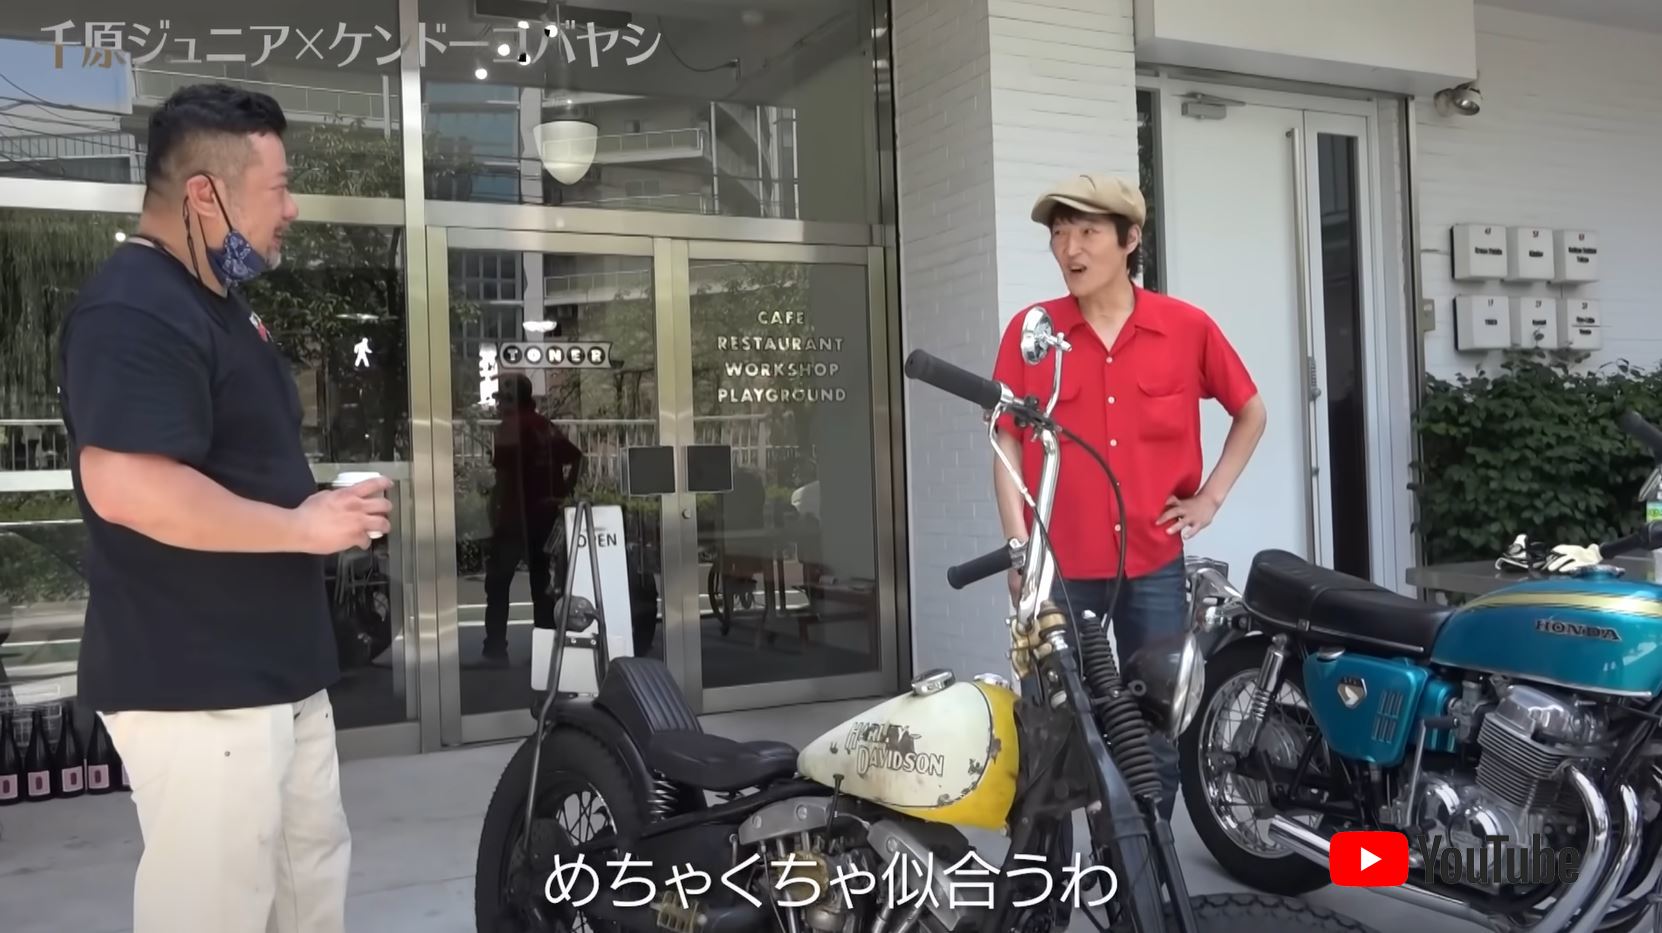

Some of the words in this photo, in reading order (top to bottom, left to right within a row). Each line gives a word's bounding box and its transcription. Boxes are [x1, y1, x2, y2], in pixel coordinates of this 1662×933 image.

[757, 311, 805, 325] CAFE
[717, 336, 844, 351] RESTAURANT
[503, 346, 605, 364] TONER
[725, 362, 839, 377] WORKSHOP
[717, 388, 846, 403] PLAYGROUND
[575, 533, 618, 549] OEN
[1535, 620, 1621, 640] HONDA
[844, 721, 910, 751] HARLY
[857, 744, 945, 777] DAVIDSON
